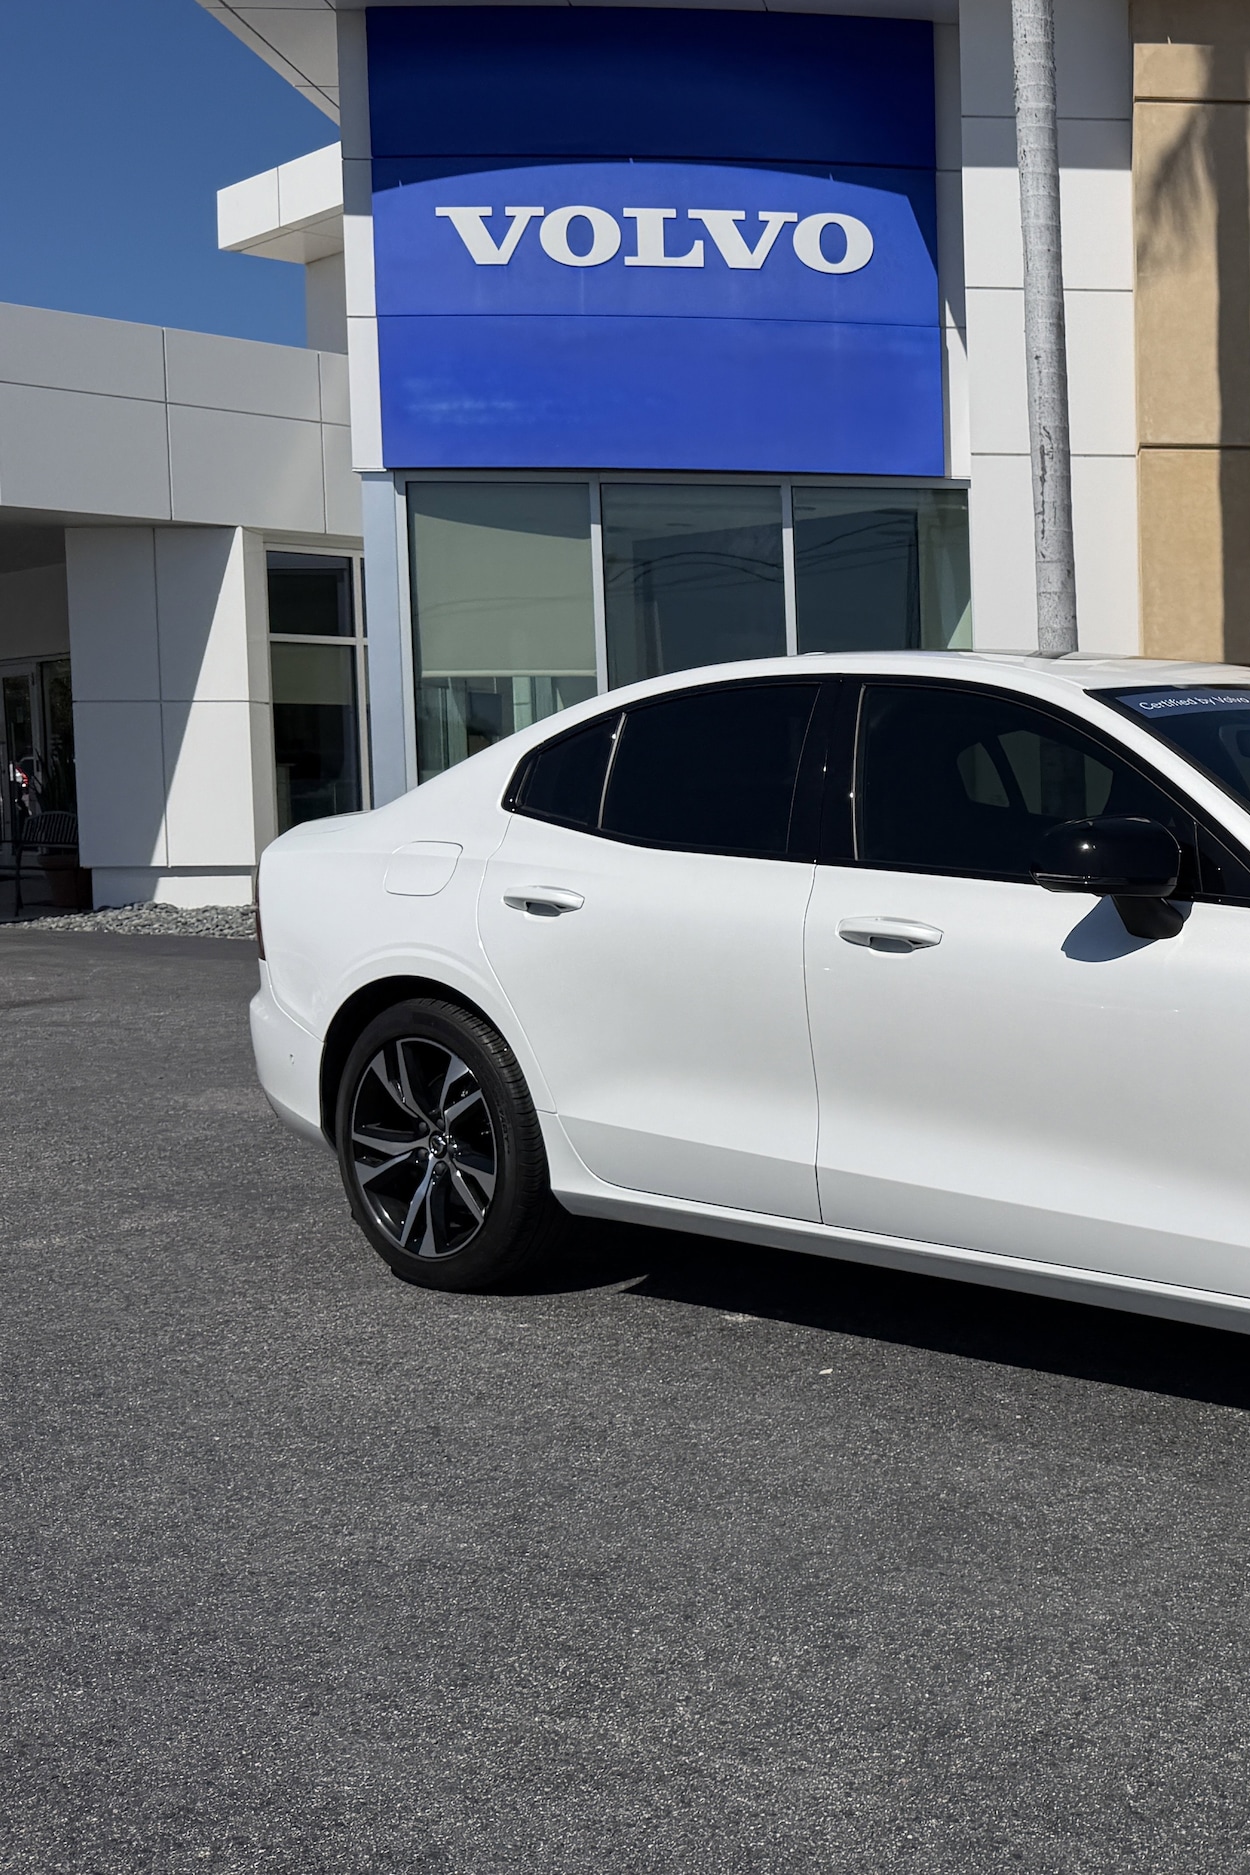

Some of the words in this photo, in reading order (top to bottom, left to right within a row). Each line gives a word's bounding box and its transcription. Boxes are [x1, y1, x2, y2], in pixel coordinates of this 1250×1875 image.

[434, 205, 875, 274] VOLVO
[1139, 697, 1196, 710] Certified
[1195, 696, 1214, 705] by
[1212, 696, 1249, 704] Volvo
